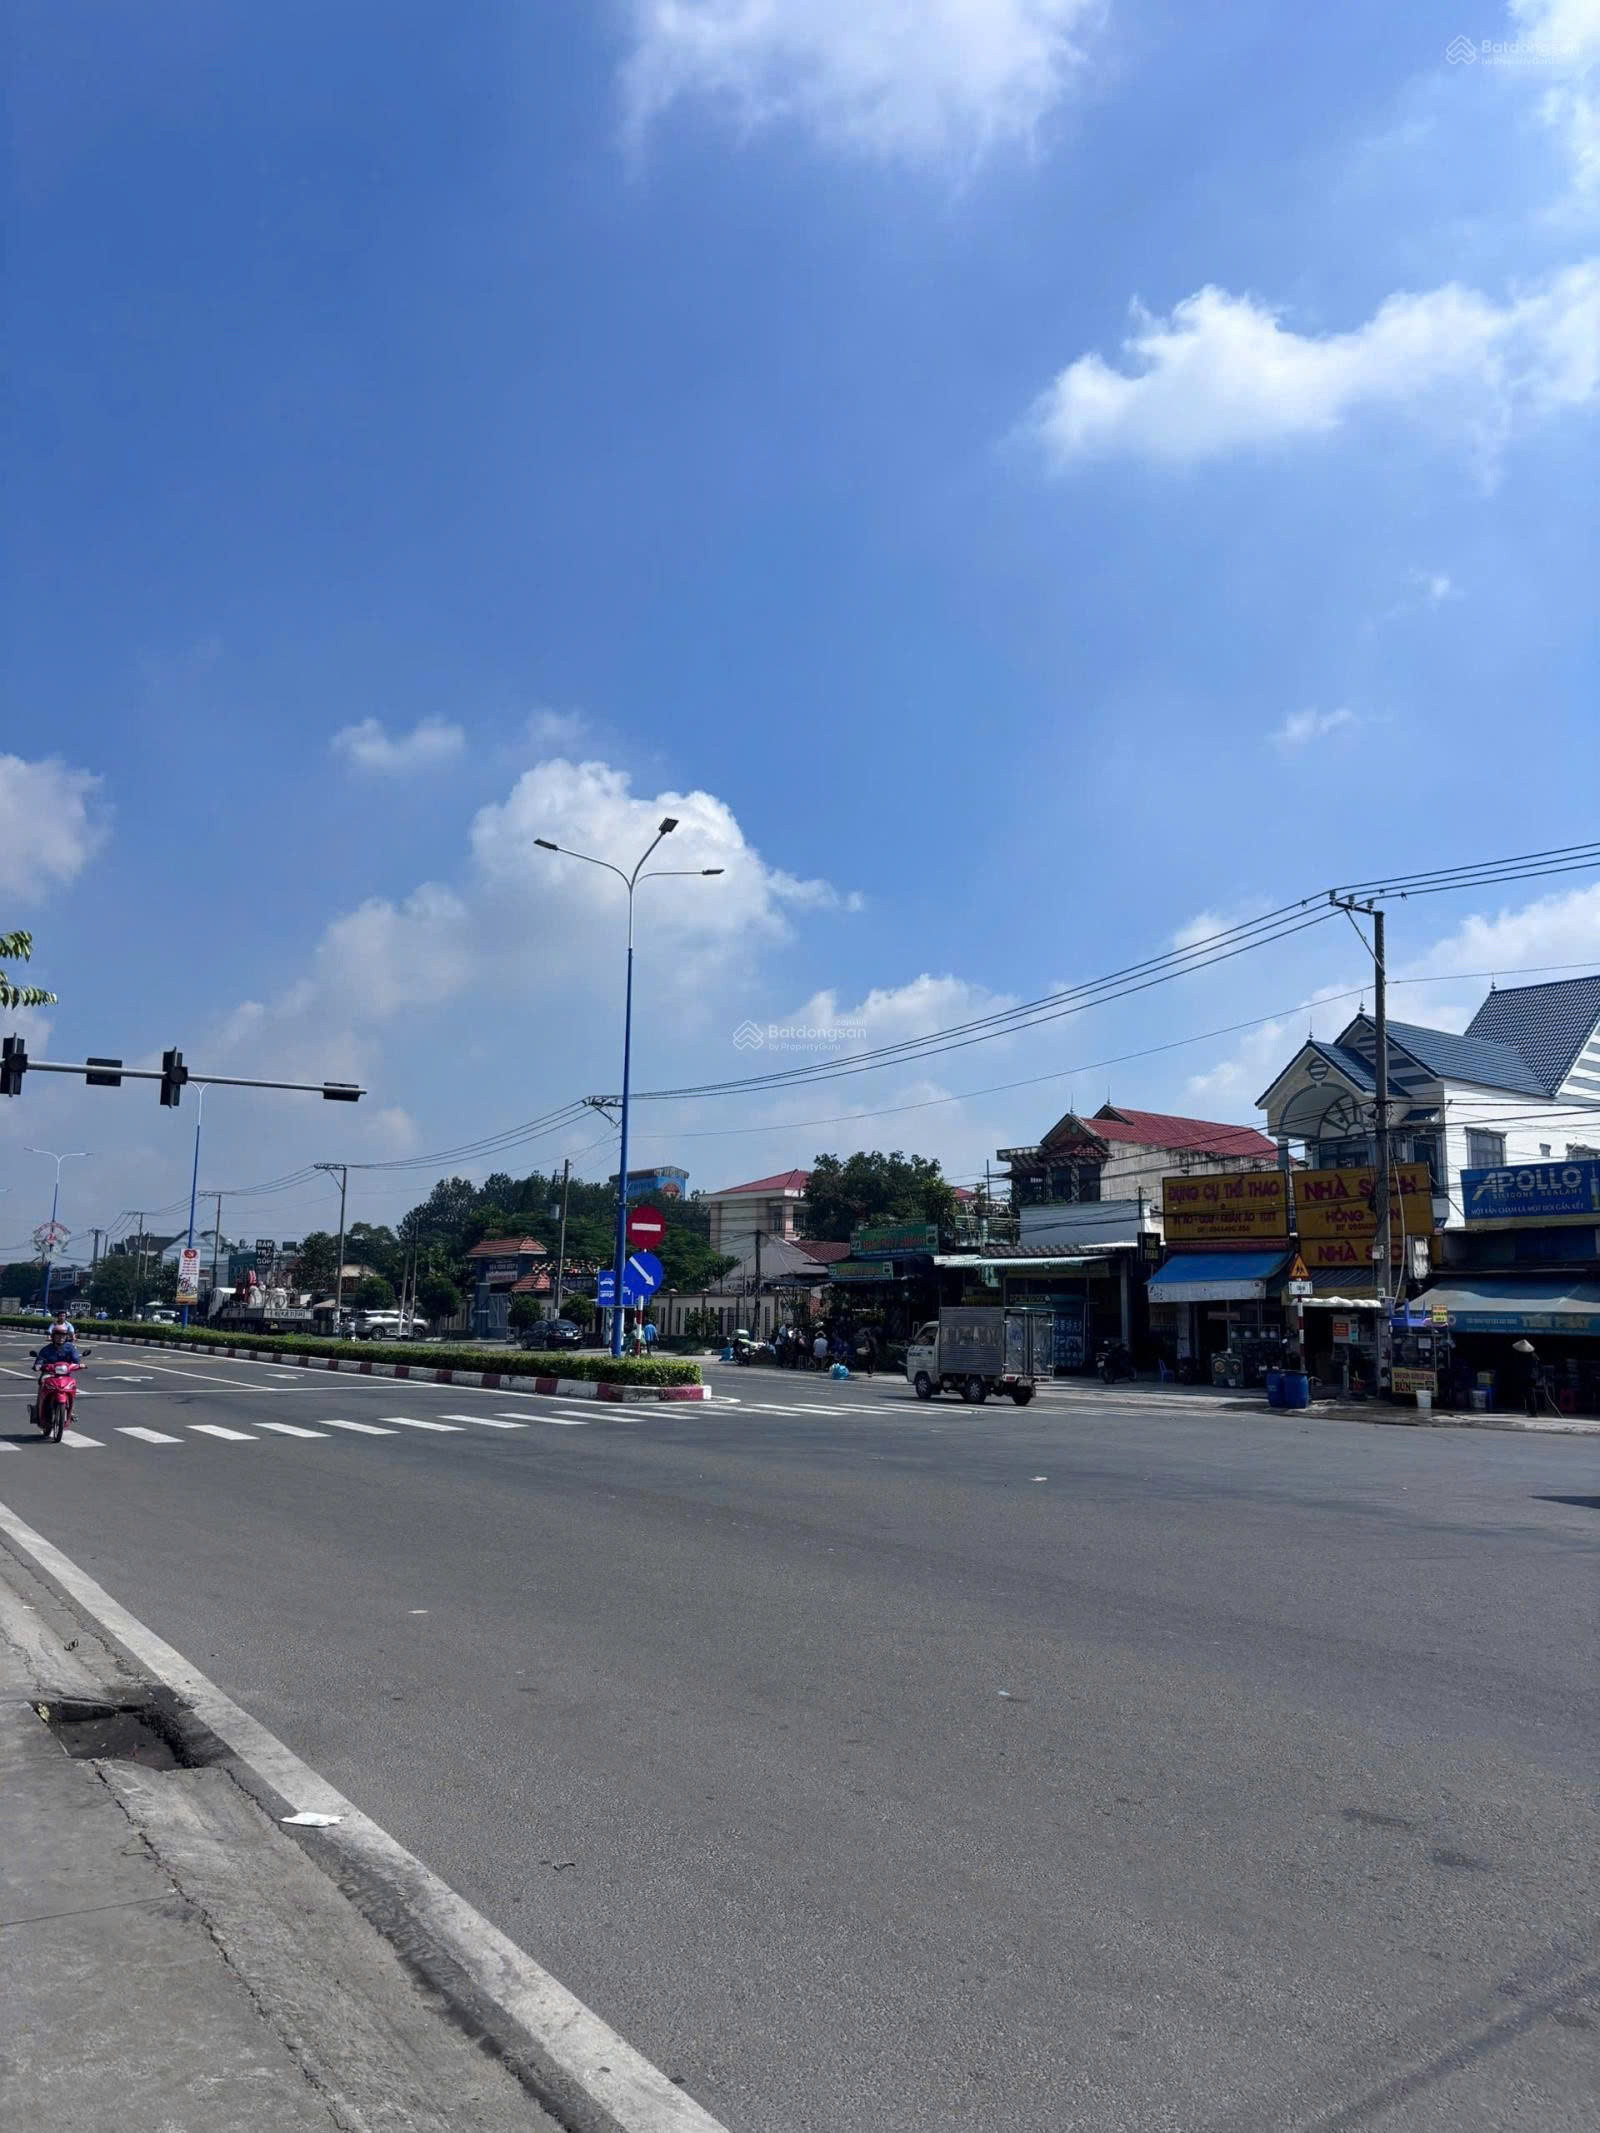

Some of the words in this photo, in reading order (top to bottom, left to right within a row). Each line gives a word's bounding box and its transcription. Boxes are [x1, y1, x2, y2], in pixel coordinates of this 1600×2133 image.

[1247, 1180, 1280, 1199] THAO
[1304, 1173, 1348, 1200] NHÀ
[1472, 1167, 1582, 1200] APOLLO
[1540, 1187, 1583, 1197] SEALANT
[1318, 1240, 1358, 1261] NHÀ
